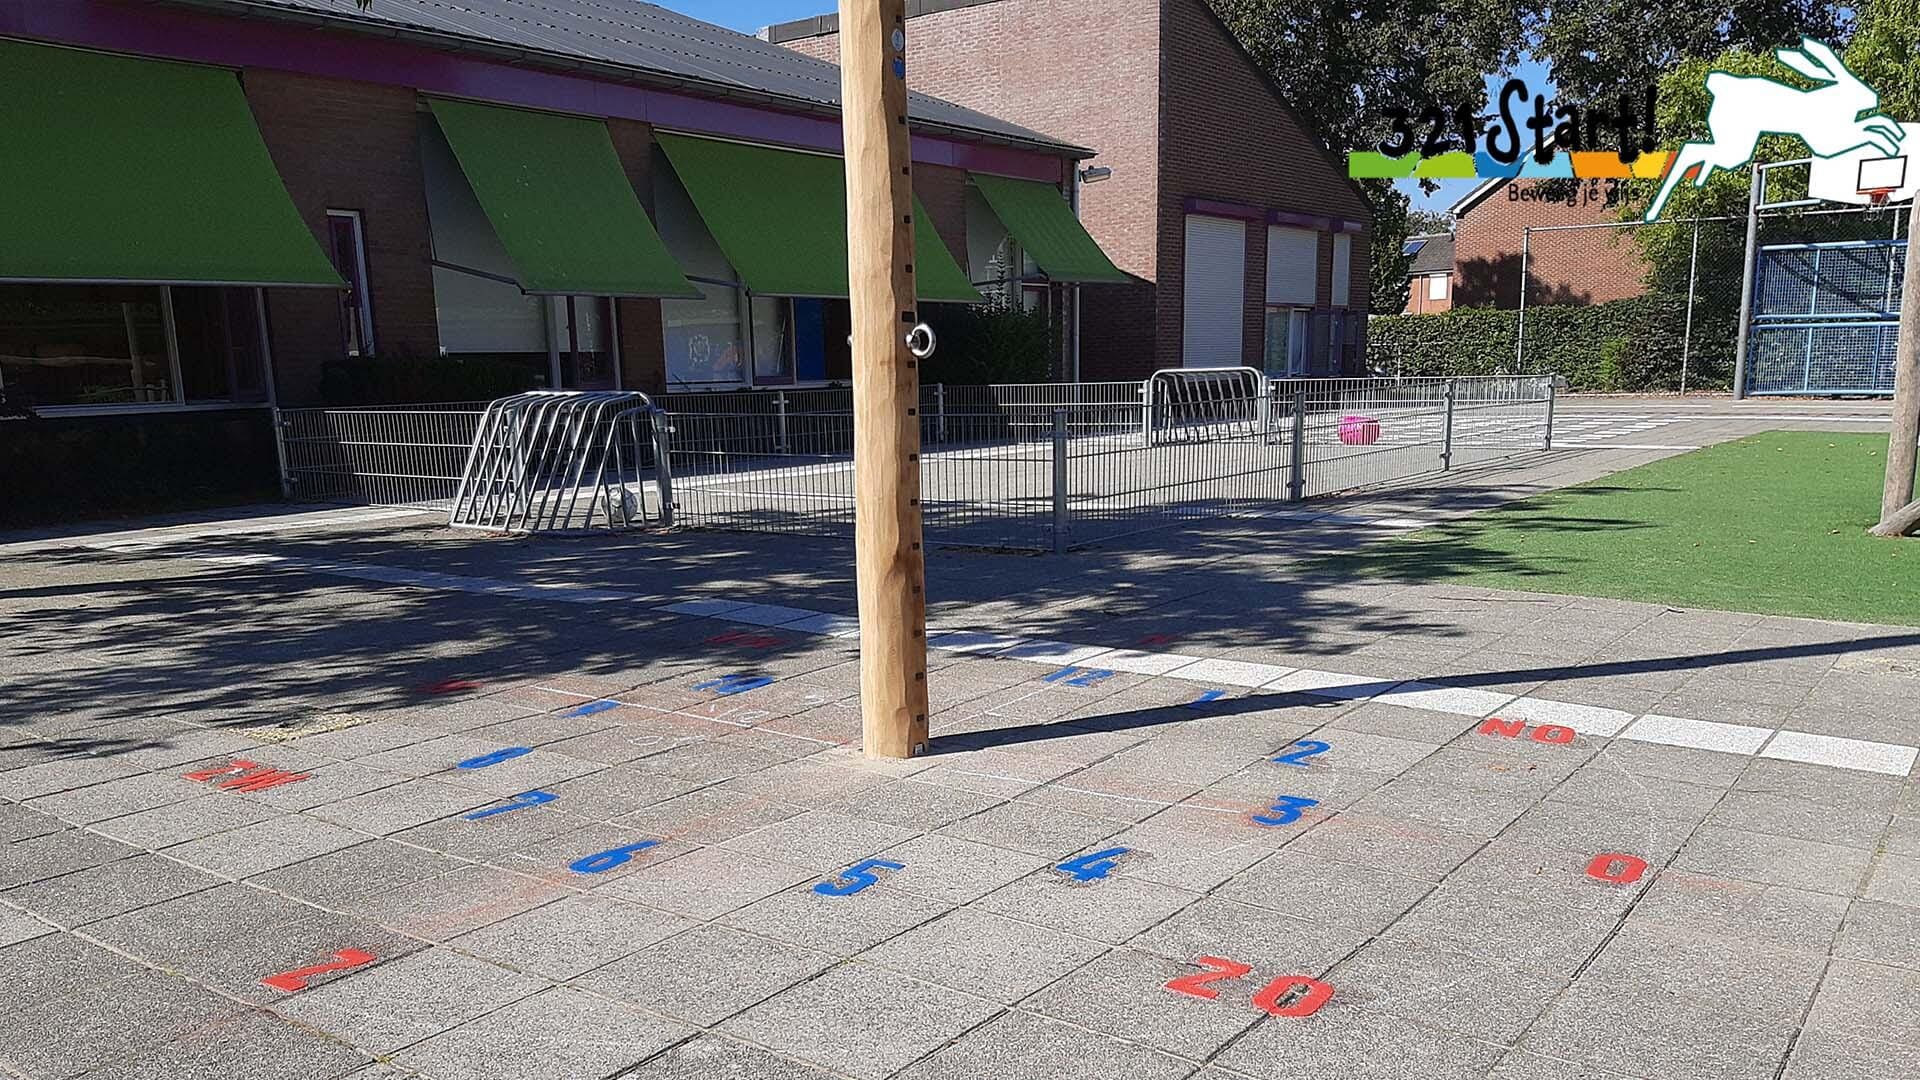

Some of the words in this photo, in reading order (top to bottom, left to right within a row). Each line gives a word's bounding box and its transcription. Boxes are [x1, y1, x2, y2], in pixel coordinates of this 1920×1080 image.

[1478, 717, 1576, 744] NO
[1273, 740, 1331, 766] 2
[1251, 795, 1320, 827] 3
[568, 838, 659, 874] 6
[1055, 846, 1130, 882] 4
[813, 857, 906, 897] 5
